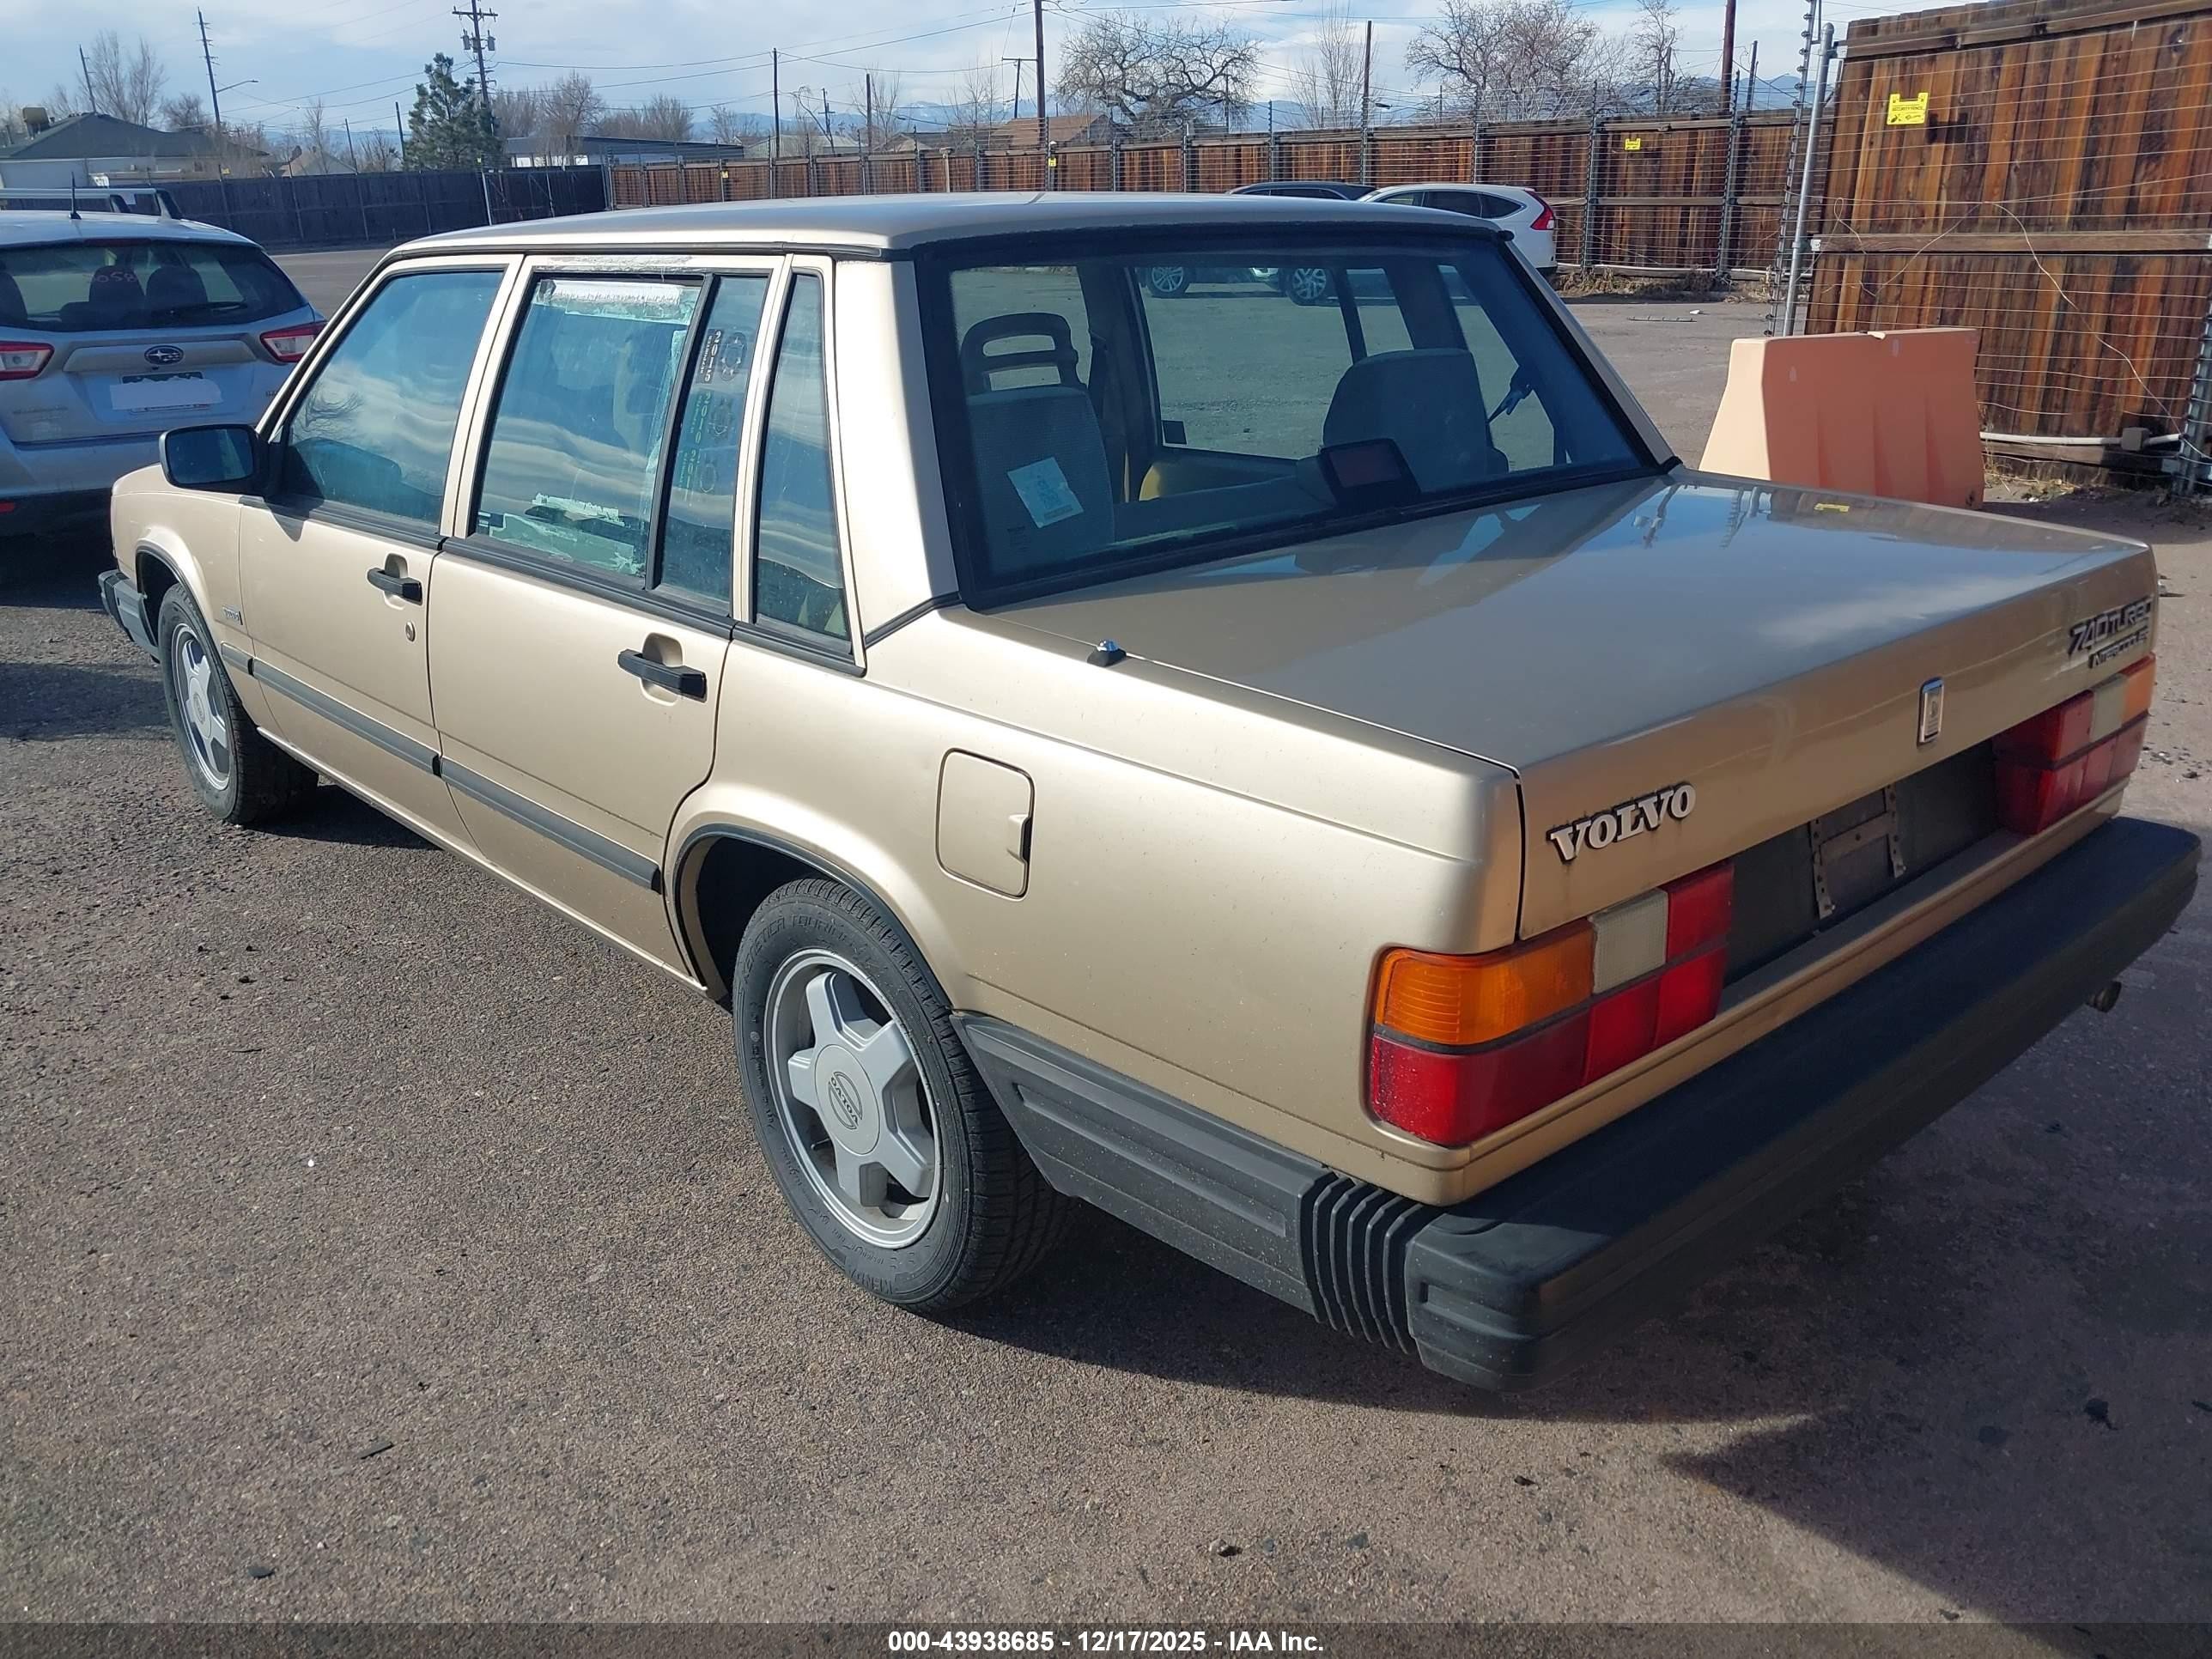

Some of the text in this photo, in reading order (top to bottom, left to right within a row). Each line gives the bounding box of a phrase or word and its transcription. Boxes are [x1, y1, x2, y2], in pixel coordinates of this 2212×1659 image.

[705, 331, 721, 382] 2015
[1547, 782, 1697, 863] VOLVO
[830, 1073, 859, 1127] VOLVO
